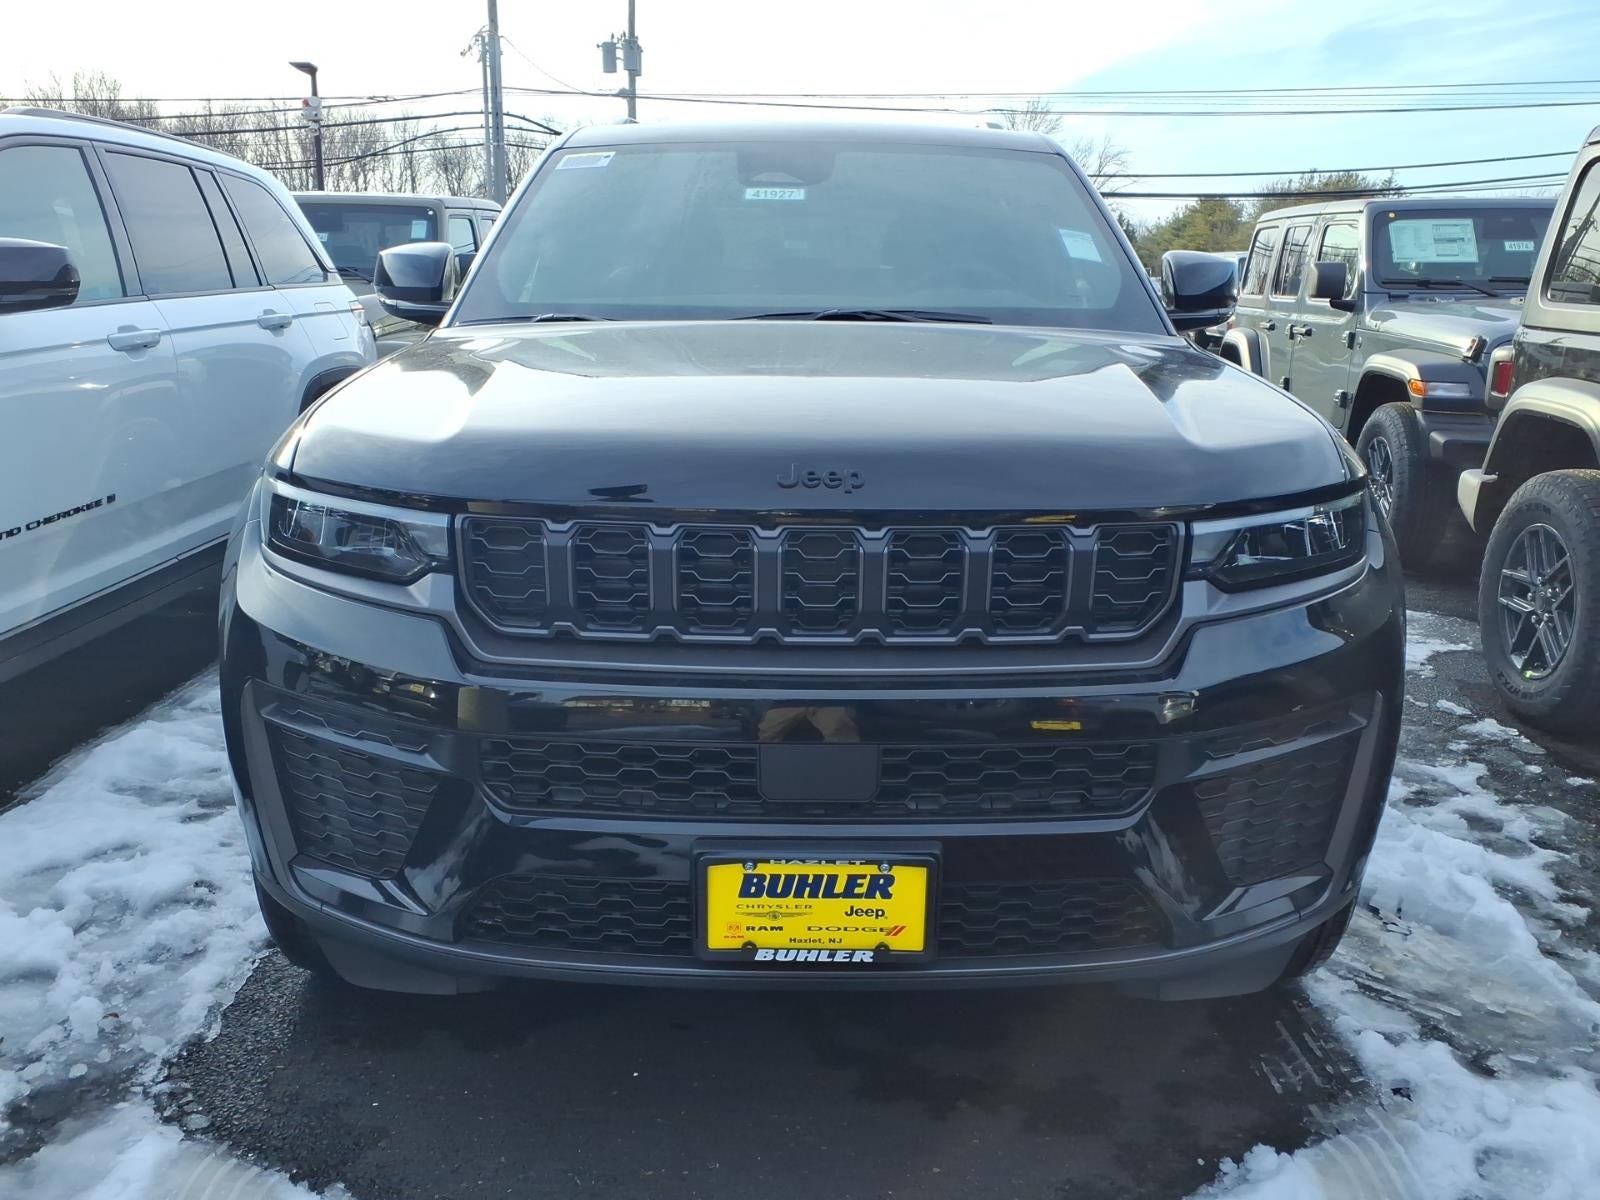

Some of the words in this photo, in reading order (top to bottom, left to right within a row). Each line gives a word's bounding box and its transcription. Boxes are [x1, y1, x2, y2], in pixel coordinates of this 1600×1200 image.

[751, 190, 795, 199] 41927
[776, 463, 864, 495] Jeep
[25, 498, 103, 531] CHEROKEE
[738, 873, 896, 899] BUHLER
[844, 905, 886, 919] Jeep
[754, 949, 874, 962] BUHLER
